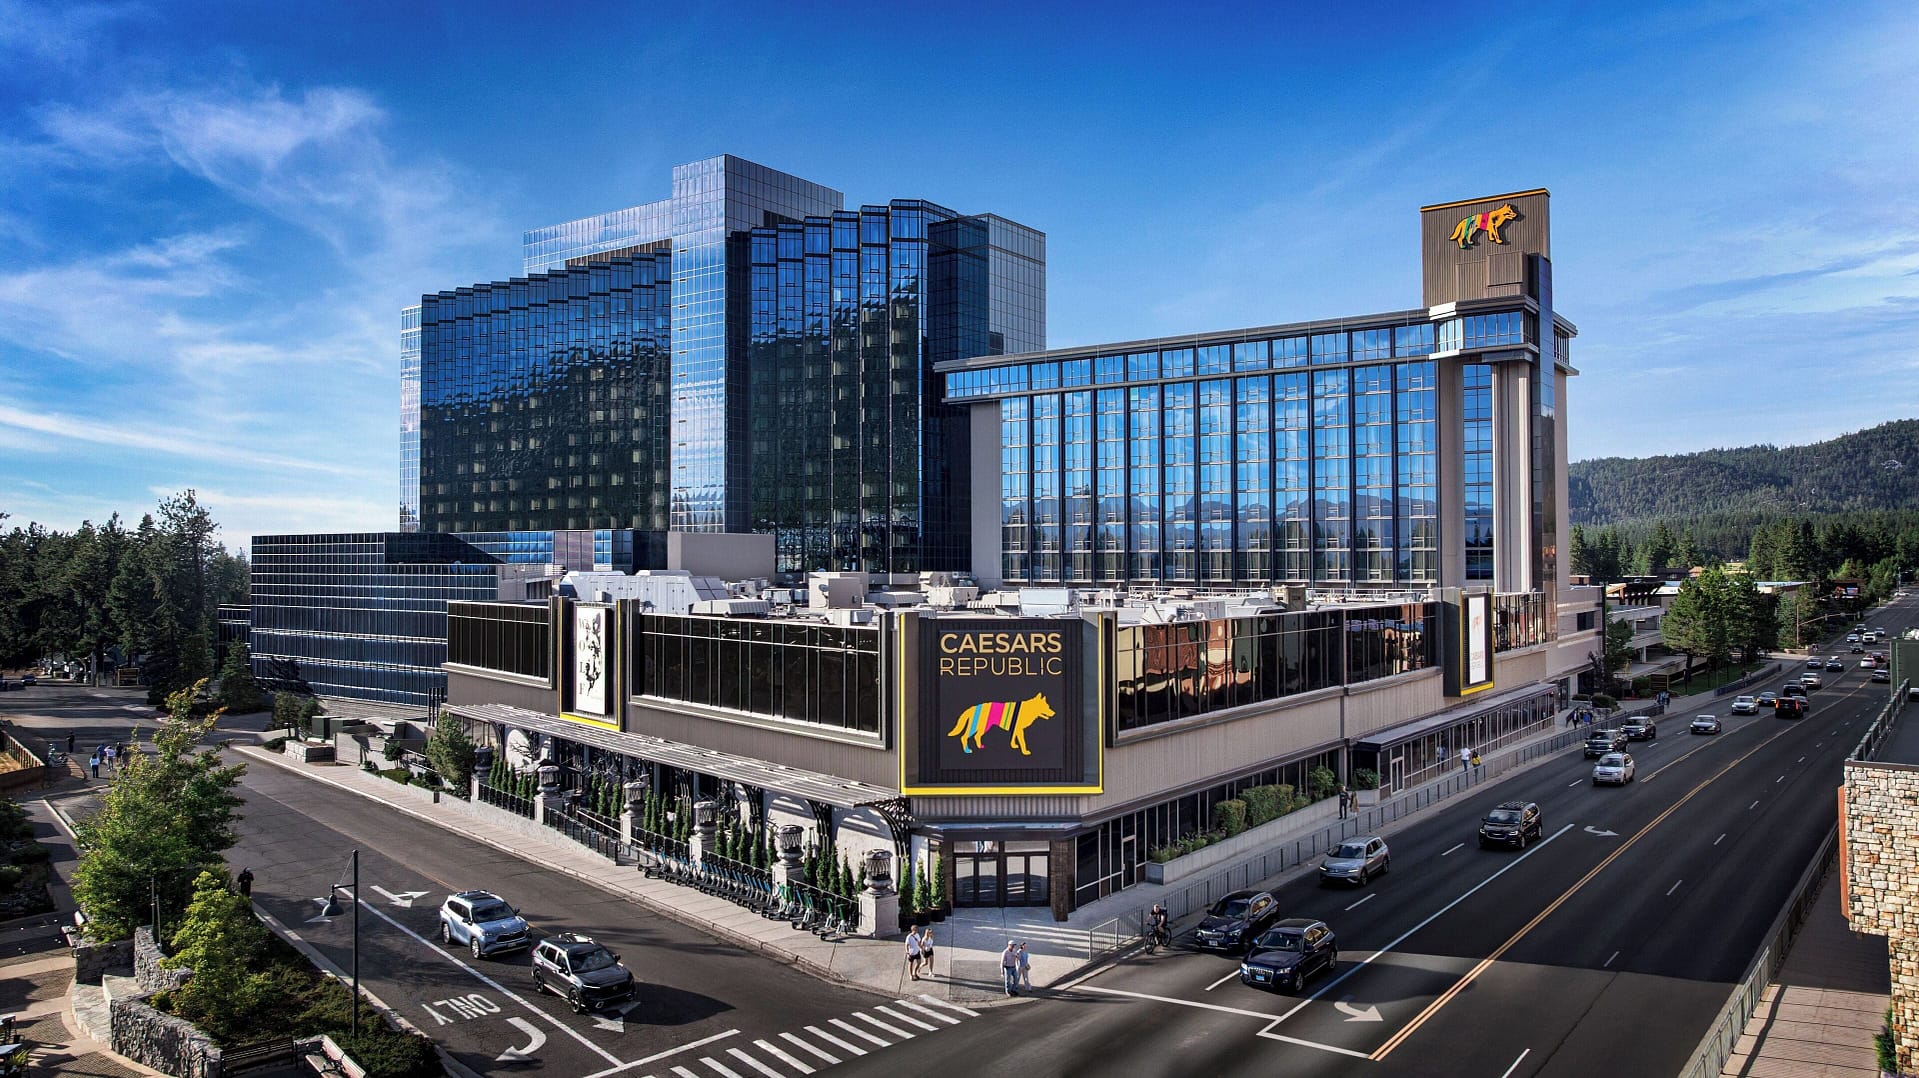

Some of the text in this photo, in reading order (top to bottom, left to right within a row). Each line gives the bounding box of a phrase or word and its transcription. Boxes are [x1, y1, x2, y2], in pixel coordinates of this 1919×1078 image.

[940, 633, 1062, 654] CAESARS
[940, 657, 1062, 676] REPUBLIC
[421, 993, 501, 1026] ONLY
